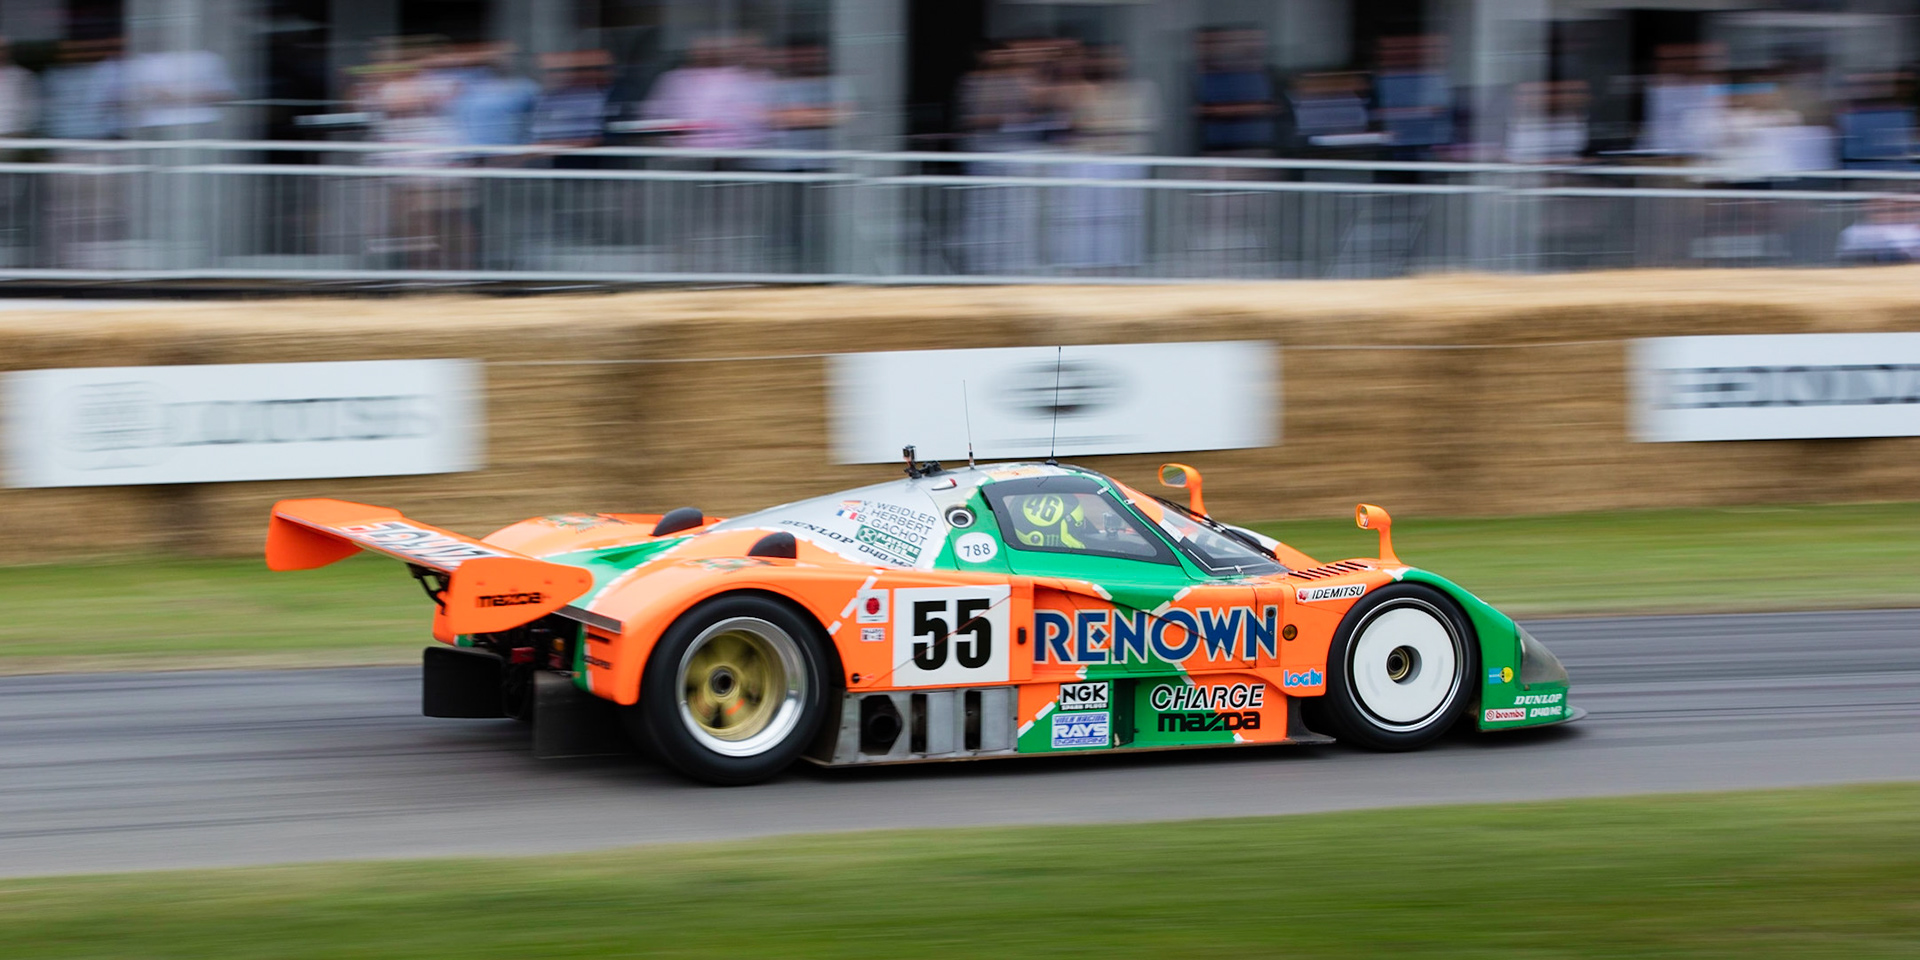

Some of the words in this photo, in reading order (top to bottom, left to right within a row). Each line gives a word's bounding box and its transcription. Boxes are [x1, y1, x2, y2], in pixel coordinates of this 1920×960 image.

[877, 502, 937, 526] WEIDLER
[1026, 493, 1060, 522] 46
[780, 519, 855, 545] DUNLOP
[871, 509, 933, 536] HERBERT
[871, 518, 928, 546] GACHOT
[963, 542, 991, 558] 788
[1311, 585, 1365, 600] IDEMITSU
[912, 598, 992, 671] 55
[1033, 604, 1278, 665] RENOWN
[1062, 684, 1106, 703] NGK
[1150, 683, 1267, 711] CHARGE
[1513, 693, 1563, 705] DUNLOP
[1157, 711, 1261, 733] mazda
[1495, 709, 1525, 719] brembo
[1053, 723, 1107, 738] RAYS
